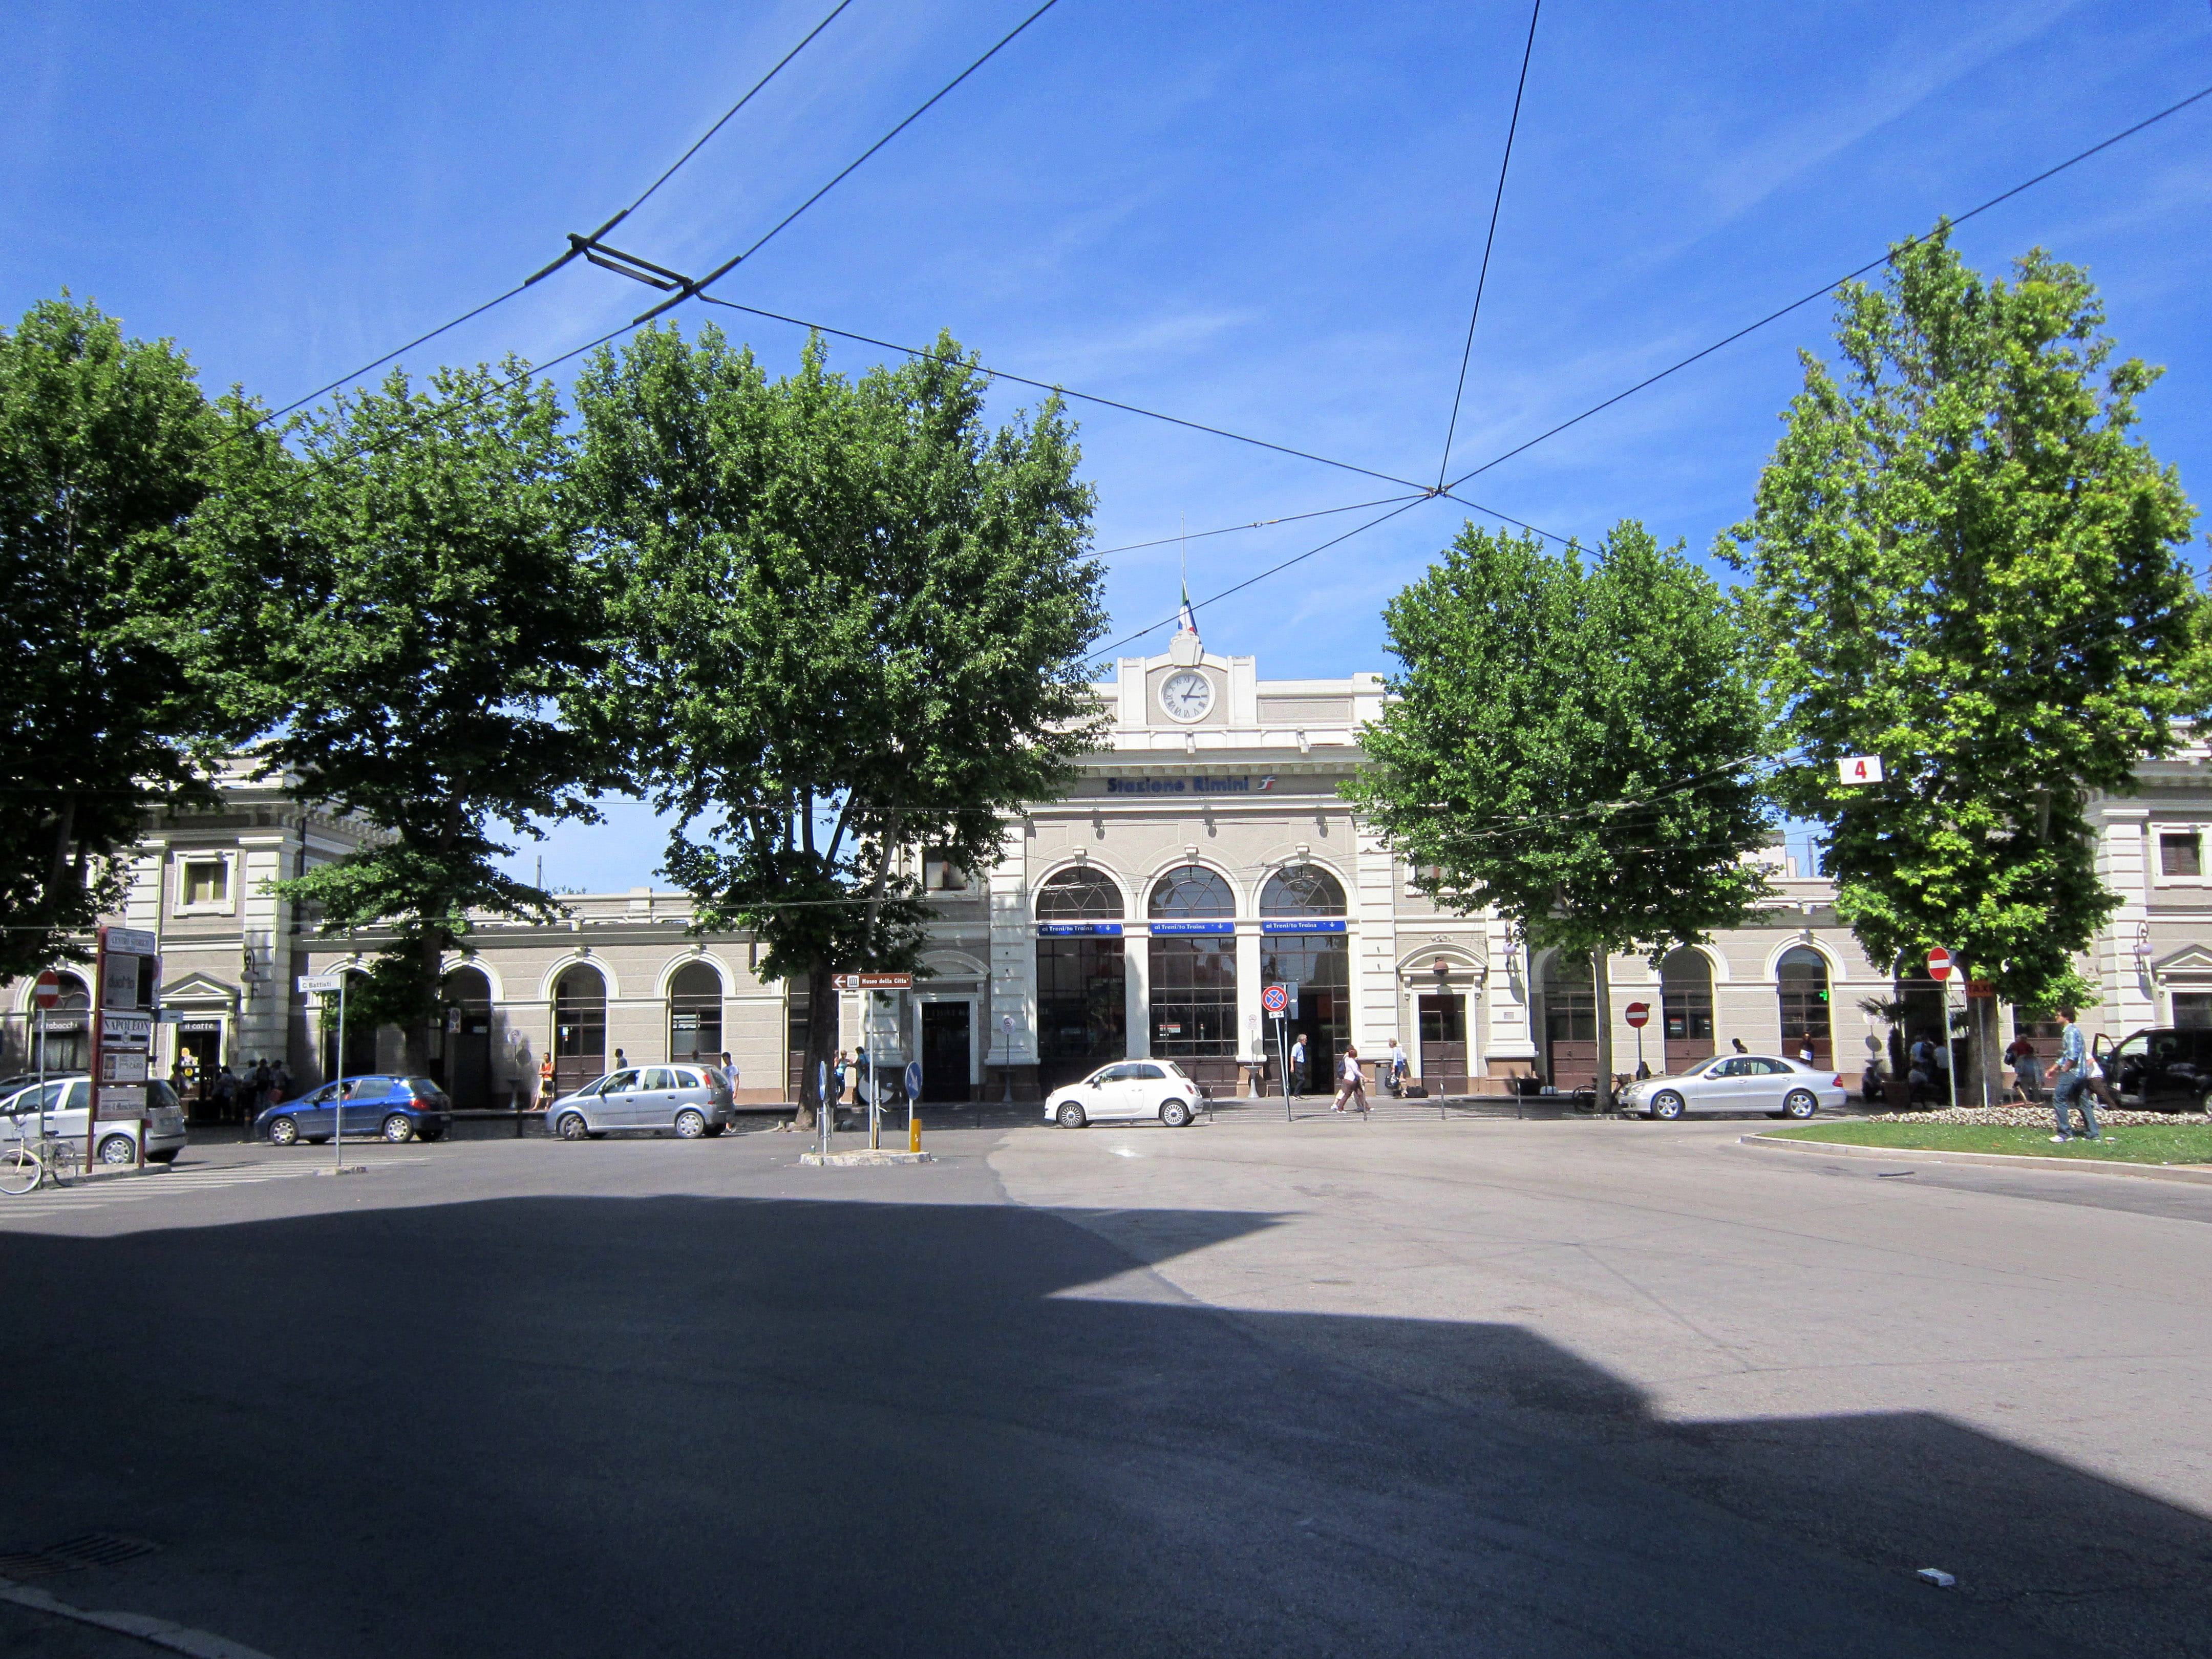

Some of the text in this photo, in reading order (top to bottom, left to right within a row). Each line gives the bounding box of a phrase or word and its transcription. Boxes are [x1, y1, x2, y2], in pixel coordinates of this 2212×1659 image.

[1855, 760, 1867, 779] 4
[1107, 776, 1249, 793] Stazione Rimini
[1968, 984, 1992, 993] TAXI
